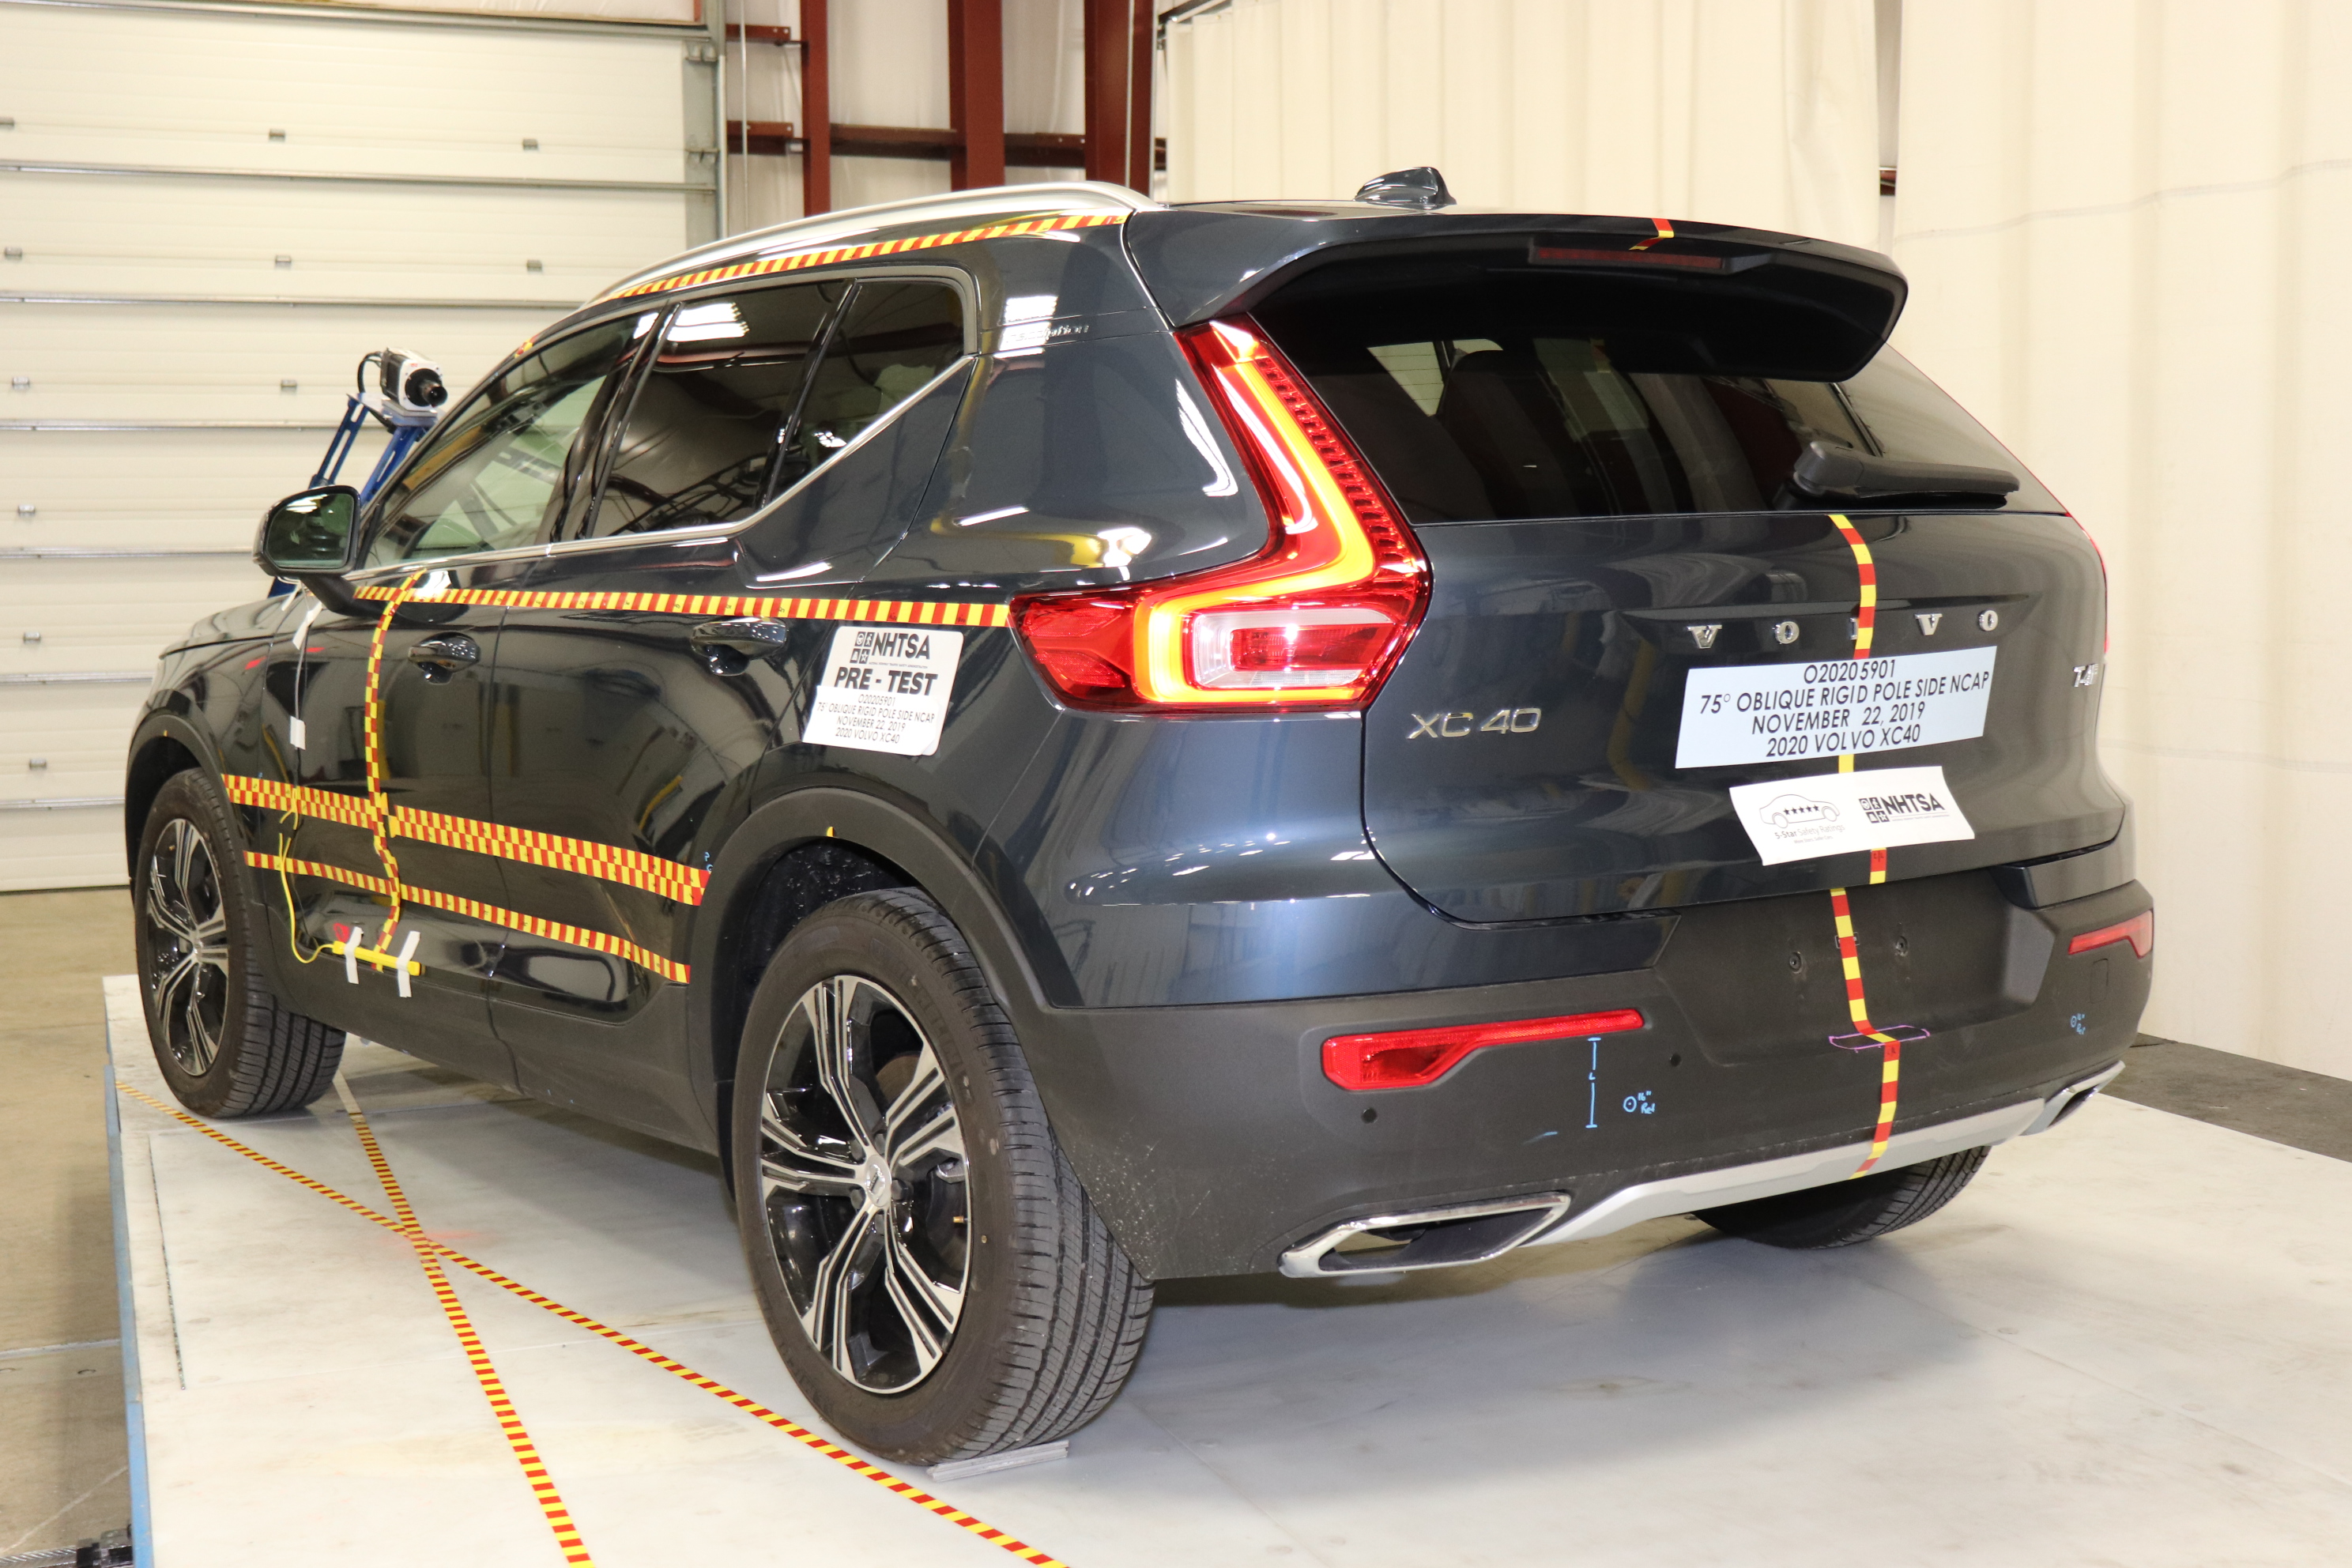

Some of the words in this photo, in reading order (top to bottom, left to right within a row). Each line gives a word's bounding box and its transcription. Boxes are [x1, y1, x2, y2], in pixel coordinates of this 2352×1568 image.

[871, 632, 930, 659] NHTSA
[834, 666, 873, 690] PRE
[888, 670, 938, 695] TEST
[1700, 693, 1731, 714] 75°
[1736, 688, 1815, 712] OBLIQUE
[1820, 684, 1868, 707] RIGID
[1873, 680, 1912, 702] POLE
[1915, 677, 1947, 697] SIDE
[1950, 671, 1989, 693] NCAP
[828, 703, 857, 714] OBLIQUE
[858, 706, 876, 717] RIGID
[877, 707, 896, 718] POLE
[897, 710, 914, 721] SIDE
[914, 712, 935, 723] NCAP
[836, 715, 875, 728] NOVEMBER
[888, 721, 906, 732] 2019
[1751, 709, 1850, 735] NOVEMBER
[1861, 706, 1884, 726] 22,
[1889, 701, 1925, 723] 2019
[835, 727, 853, 738] 2020
[854, 729, 879, 741] VOLVO
[880, 733, 900, 744] XC40
[1766, 735, 1808, 757] 2020
[1815, 729, 1875, 752] VOLVO
[1879, 724, 1920, 746] XC40
[1880, 793, 1946, 815] NHTSA
[1774, 831, 1797, 839] 5-Star
[1797, 827, 1819, 836] Safety
